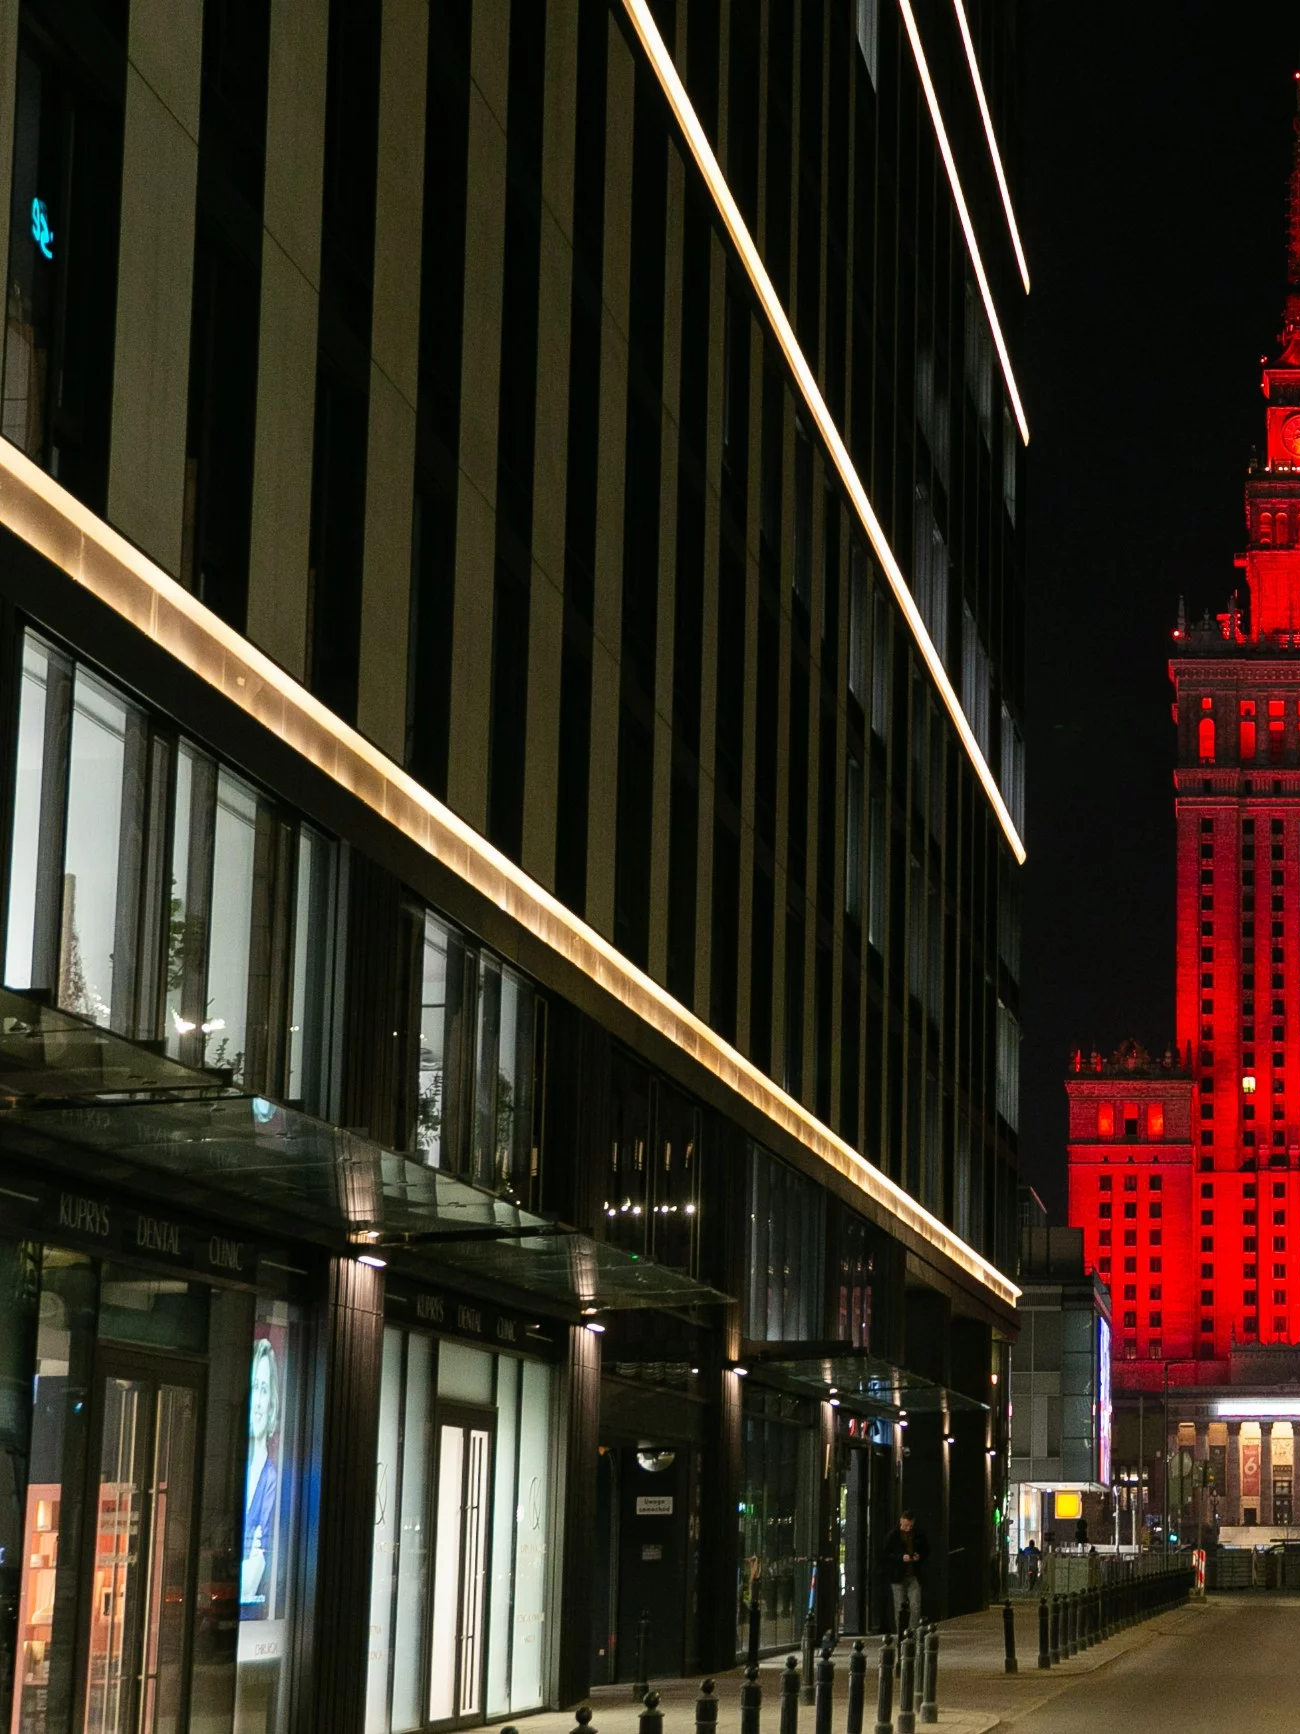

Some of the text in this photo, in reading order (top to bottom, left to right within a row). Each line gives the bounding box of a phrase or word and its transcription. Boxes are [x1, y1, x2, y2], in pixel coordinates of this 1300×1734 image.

[137, 1216, 180, 1254] DENTAL
[209, 1236, 244, 1270] CLINIC
[458, 1304, 481, 1332] DENTAL
